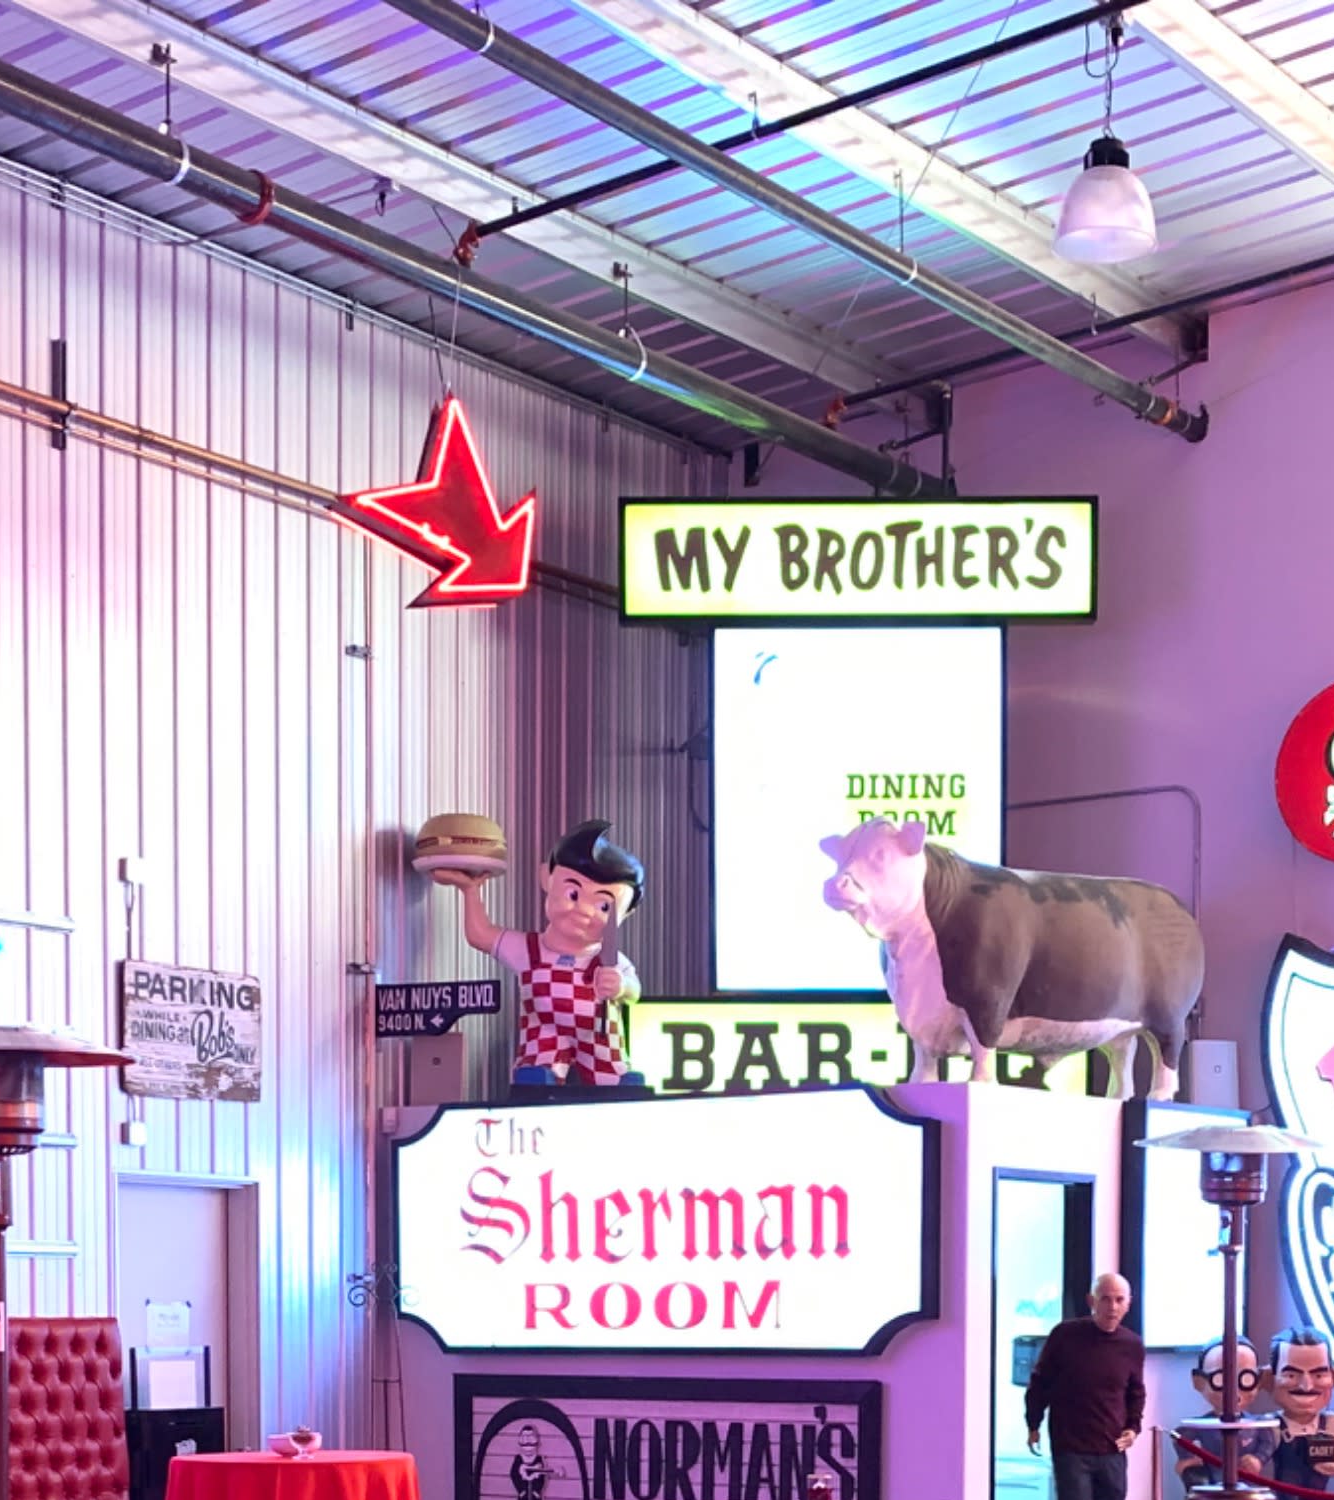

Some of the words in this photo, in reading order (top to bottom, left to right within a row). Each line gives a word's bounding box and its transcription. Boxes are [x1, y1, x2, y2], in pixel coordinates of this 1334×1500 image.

[654, 524, 751, 593] MY
[773, 517, 1067, 595] BROTHER'S
[845, 773, 966, 799] DINING
[133, 970, 256, 1012] PARKING
[378, 988, 406, 1012] VAN
[410, 986, 452, 1010] NUYS
[458, 983, 495, 1009] BLVD.
[130, 1020, 177, 1042] DINING
[190, 1009, 236, 1063] Bob's
[378, 1013, 412, 1032] 9400
[475, 1117, 546, 1158] The
[459, 1166, 852, 1266] Sherman
[524, 1279, 783, 1331] ROOM
